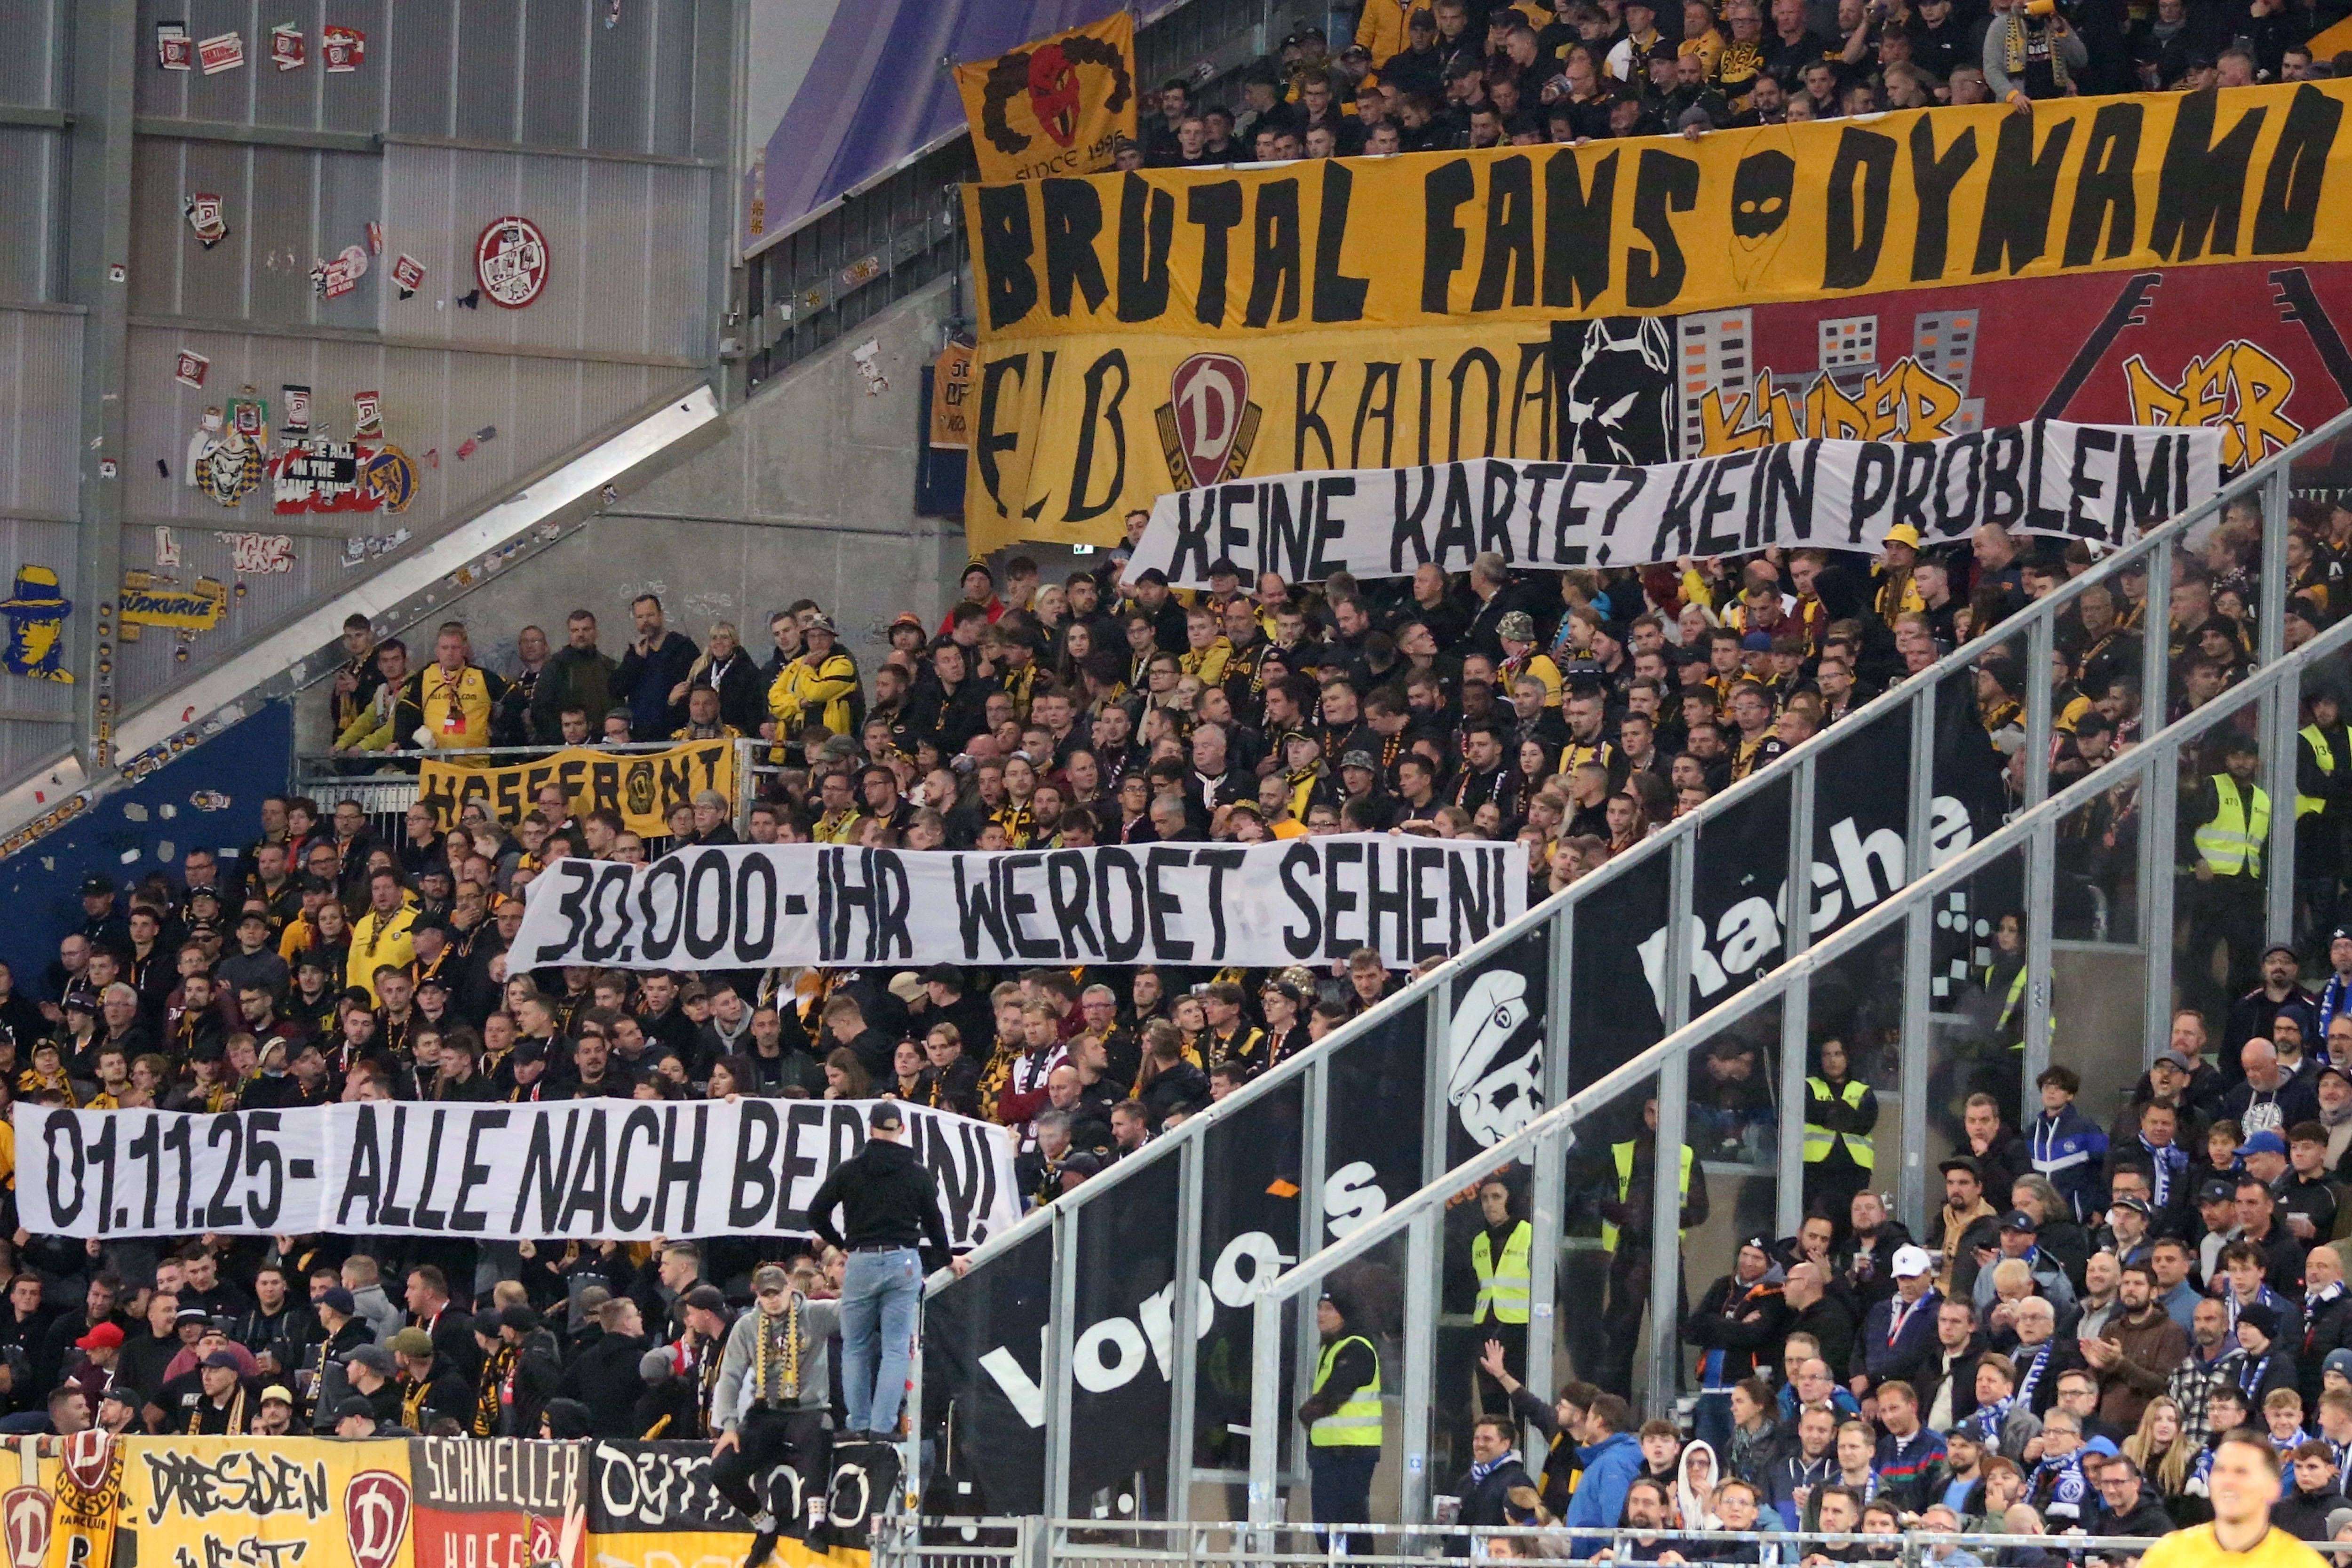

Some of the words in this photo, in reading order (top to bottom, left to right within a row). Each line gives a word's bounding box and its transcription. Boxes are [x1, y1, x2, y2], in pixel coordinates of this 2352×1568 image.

[978, 160, 1369, 331] BRUTAL
[1421, 148, 1700, 314] FANS
[1821, 83, 2344, 289] DYNAMO
[1697, 356, 1963, 457] KINDER
[2122, 339, 2304, 472] DER
[310, 460, 335, 478] THE
[1167, 477, 1356, 588] KEINE
[1389, 460, 1647, 572] KARTE?
[1651, 438, 1823, 562] KEIN
[952, 847, 1246, 962] WERDET
[336, 1104, 511, 1231] ALLE
[510, 1105, 708, 1234] NACH
[142, 1450, 328, 1525] DRESDEN
[424, 1438, 579, 1507] SCHNELLER
